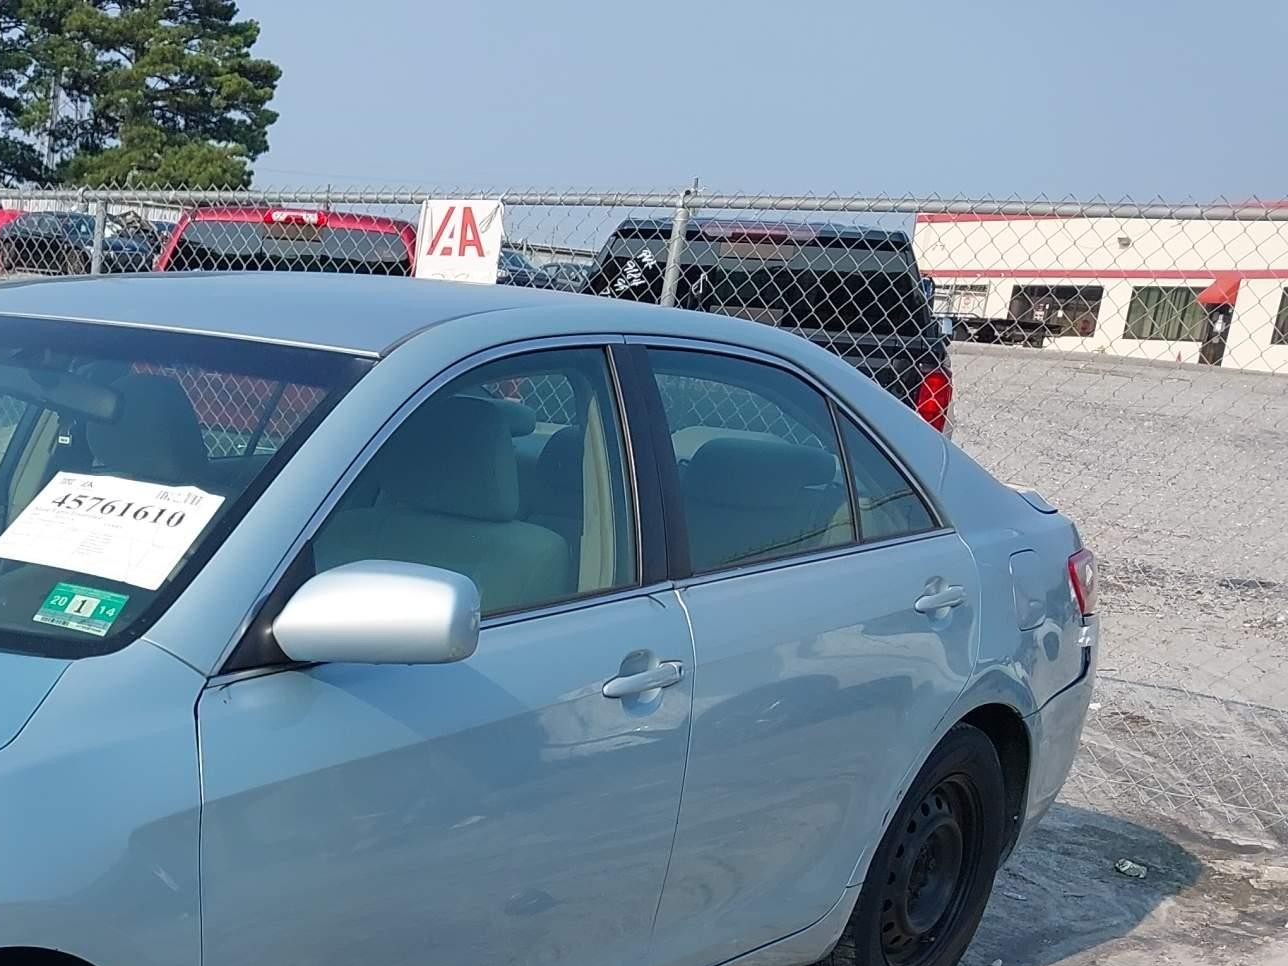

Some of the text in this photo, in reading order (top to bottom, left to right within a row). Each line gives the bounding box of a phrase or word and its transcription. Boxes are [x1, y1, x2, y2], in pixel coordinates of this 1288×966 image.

[52, 493, 187, 527] 45761610
[49, 595, 116, 617] 20 1 14
